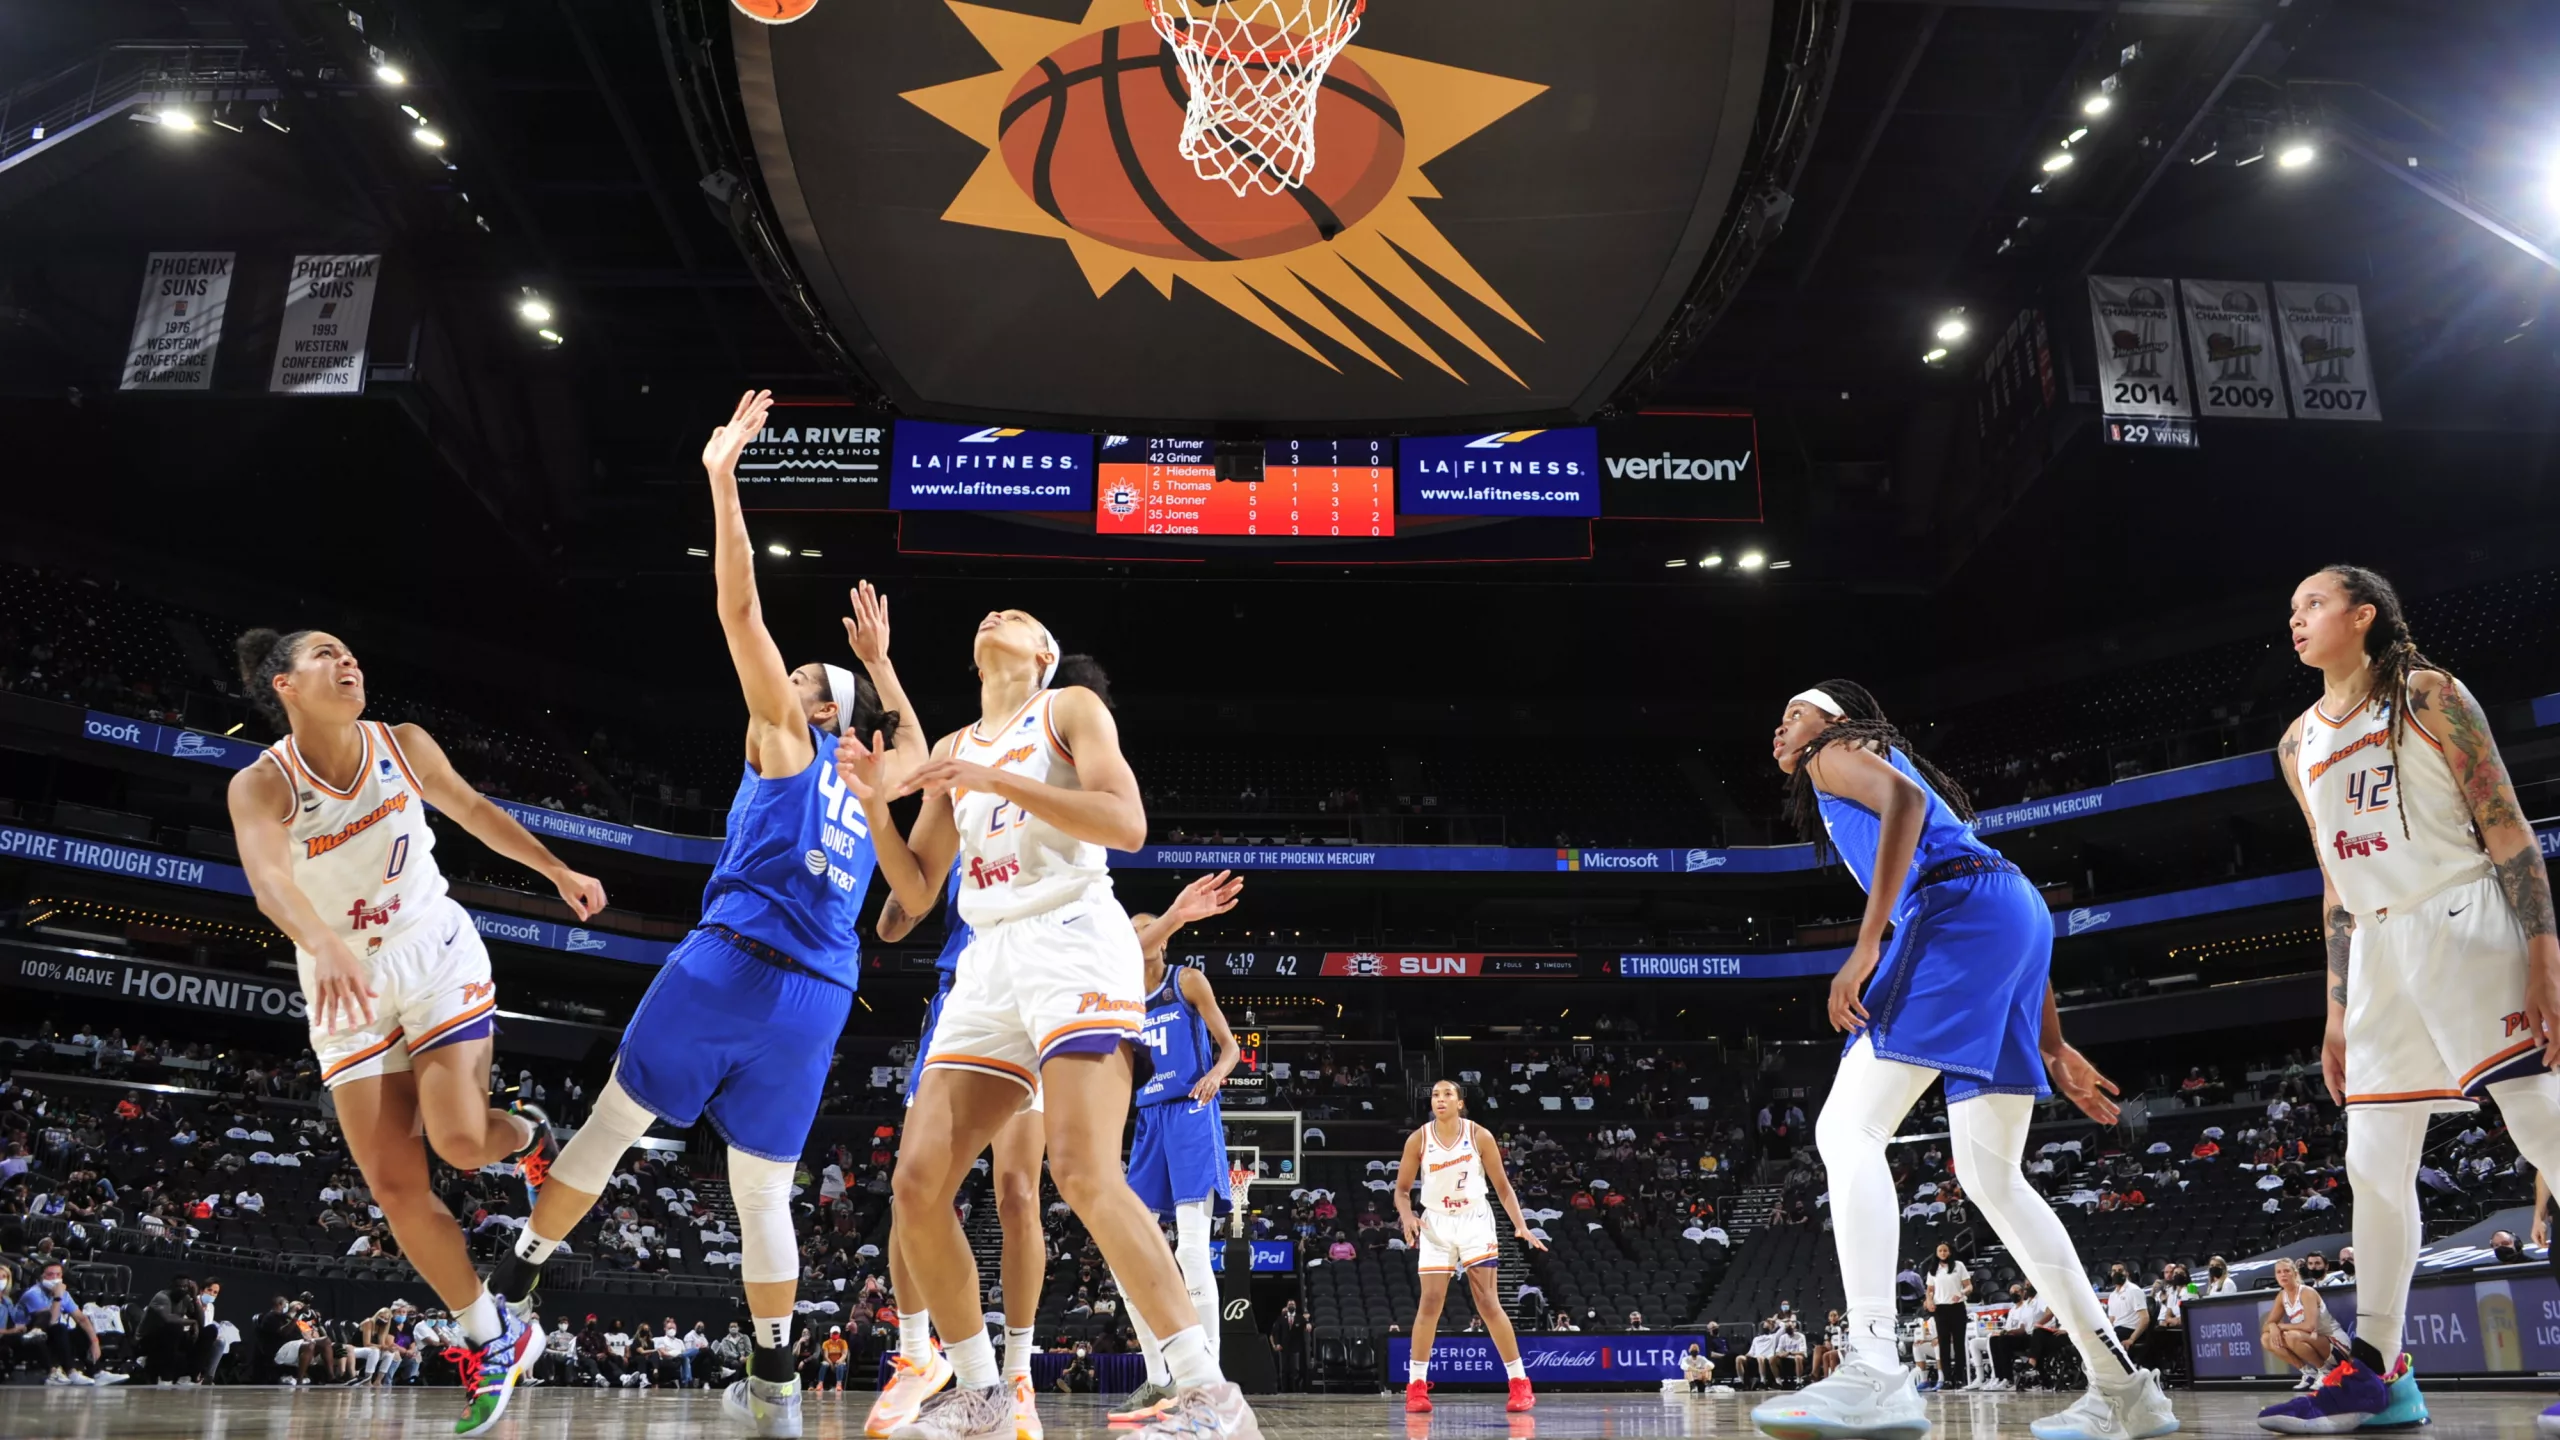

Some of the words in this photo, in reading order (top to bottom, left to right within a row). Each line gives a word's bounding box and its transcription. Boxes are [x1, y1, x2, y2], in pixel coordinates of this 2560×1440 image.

[151, 258, 229, 275] PHOENIX
[297, 261, 373, 278] PHOENIX
[161, 279, 208, 296] SUNS
[308, 281, 354, 299] SUNS
[2101, 309, 2168, 321] CHAMPIONS
[2195, 311, 2261, 323] CHAMPIONS
[2288, 313, 2353, 326] CHAMPIONS
[164, 321, 191, 333] 1976
[311, 323, 338, 336] 1993
[147, 338, 202, 350] WESTERN
[294, 340, 349, 352] WESTERN
[134, 354, 207, 367] CONFERENCE
[282, 356, 355, 368] CONFERENCE
[133, 370, 201, 383] CHAMPIONS
[282, 372, 349, 385] CHAMPIONS
[2114, 383, 2179, 406] 2014
[2208, 385, 2274, 409] 2009
[2303, 388, 2368, 410] 2007
[805, 428, 880, 443] RIVER
[2123, 424, 2149, 443] 29
[2155, 432, 2190, 446] WINS
[1150, 439, 1164, 448] 21
[1166, 438, 1204, 449] Turner
[1291, 440, 1299, 450] 0
[1332, 441, 1337, 450] 1
[1370, 441, 1379, 451] 0
[1150, 453, 1164, 463] 42
[1167, 453, 1202, 463] Griner
[1291, 455, 1299, 465] 3
[1332, 455, 1338, 464] 1
[1371, 455, 1379, 465] 0
[1605, 452, 1736, 481] verizon
[1153, 466, 1160, 476] 2
[1292, 468, 1297, 477] 1
[1332, 468, 1337, 478] 1
[1371, 469, 1379, 479] 0
[911, 481, 1071, 497] www.lafitness.com
[1153, 481, 1160, 490] 5
[1167, 480, 1212, 491] Thomas
[1249, 482, 1256, 491] 6
[1292, 482, 1297, 491] 1
[1332, 482, 1339, 492] 3
[1372, 483, 1378, 493] 1
[1421, 487, 1579, 501] www.lafitness.com
[1149, 495, 1163, 505] 24
[1165, 495, 1206, 505] Bonner
[1249, 496, 1257, 506] 5
[1292, 496, 1297, 506] 1
[1332, 497, 1339, 507] 3
[1372, 497, 1378, 507] 1
[1148, 509, 1162, 519] 35
[1165, 509, 1199, 519] Jones
[1249, 510, 1256, 520] 9
[1291, 511, 1299, 521] 6
[1332, 511, 1339, 521] 3
[1372, 512, 1379, 522] 2
[1148, 524, 1163, 534] 42
[1165, 524, 1199, 534] Jones
[1249, 525, 1256, 535] 6
[1292, 525, 1299, 535] 3
[1331, 526, 1339, 536] 0
[1372, 526, 1379, 536] 0
[86, 719, 141, 744] osoft
[2308, 728, 2391, 787] Mercury
[2346, 764, 2395, 815] 42
[1985, 813, 2004, 828] THE
[2006, 803, 2051, 825] PHOENIX
[2053, 793, 2103, 816] MERCURY
[302, 791, 409, 859] Mercury
[522, 811, 541, 827] THE
[543, 818, 586, 837] PHOENIX
[587, 826, 633, 846] MERCURY
[821, 822, 855, 860] JONES
[2333, 830, 2388, 860] fry's
[0, 829, 59, 859] SPIRE
[63, 840, 152, 875] THROUGH
[155, 858, 205, 883] STEM
[383, 834, 409, 884] 0
[1157, 851, 1193, 863] PROUD
[1195, 851, 1241, 863] PARTNER
[1243, 851, 1257, 863] OF
[1259, 852, 1278, 864] THE
[1280, 852, 1325, 864] PHOENIX
[1327, 852, 1376, 865] MERCURY
[1584, 852, 1659, 869] Microsoft
[827, 863, 856, 893] AT&T
[969, 856, 1020, 889] fry's
[1225, 952, 1255, 968] 4:19
[1275, 955, 1297, 975] 42
[1399, 957, 1467, 974] SUN
[1631, 958, 1698, 975] THROUGH
[1702, 957, 1741, 975] STEM
[20, 960, 62, 980] 100%
[64, 965, 115, 987] AGAVE
[121, 967, 308, 1018] HORNITOS
[1241, 1049, 1257, 1072] 4
[1228, 1078, 1264, 1086] TISSOT
[1279, 1172, 1294, 1180] AT&T
[1455, 1171, 1468, 1191] 2
[2200, 1322, 2243, 1339] SUPERIOR
[2404, 1312, 2466, 1345] LTRA
[1410, 1347, 1487, 1358] PERIOR
[1617, 1349, 1689, 1366] ULTRA
[2196, 1343, 2221, 1358] LIGHT
[2228, 1341, 2252, 1356] BEER
[1403, 1361, 1447, 1371] LHT
[1454, 1361, 1493, 1371] BEER
[1523, 1350, 1595, 1369] Michelob
